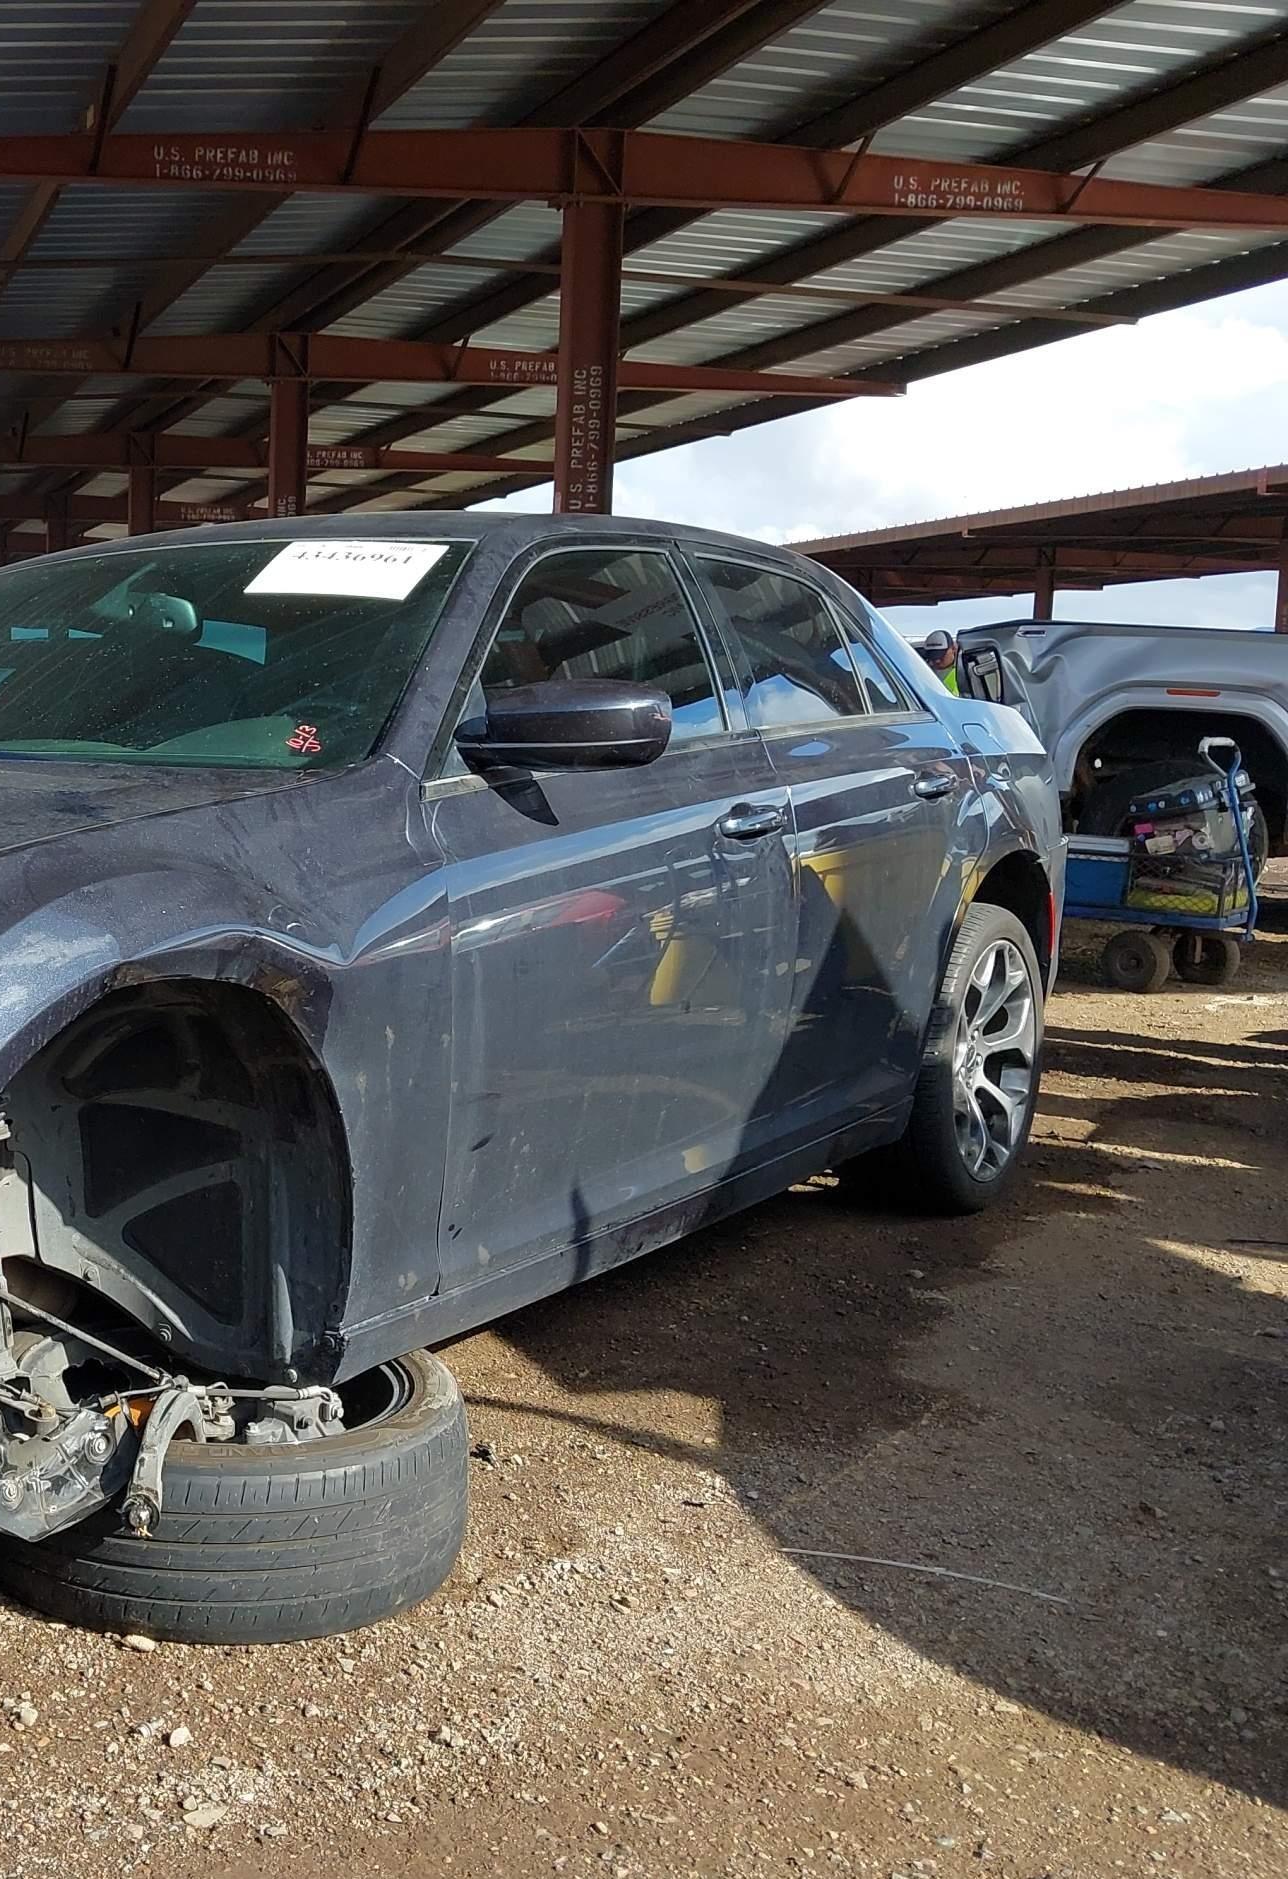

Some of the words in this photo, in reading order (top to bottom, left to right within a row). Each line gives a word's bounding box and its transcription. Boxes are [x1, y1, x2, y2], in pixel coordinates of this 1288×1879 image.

[153, 144, 185, 161] U.S.
[195, 146, 259, 164] PREFAB
[893, 175, 922, 191] U.S.
[930, 177, 990, 193] PREFAB
[997, 180, 1025, 196] INC.
[894, 192, 1024, 212] 1-866-799-0969
[489, 359, 510, 371] U.S.
[514, 360, 555, 372] PREFAB
[571, 404, 586, 469] PREFAB
[584, 365, 602, 508] 1-866-799-0969
[285, 724, 317, 749] 10-13
